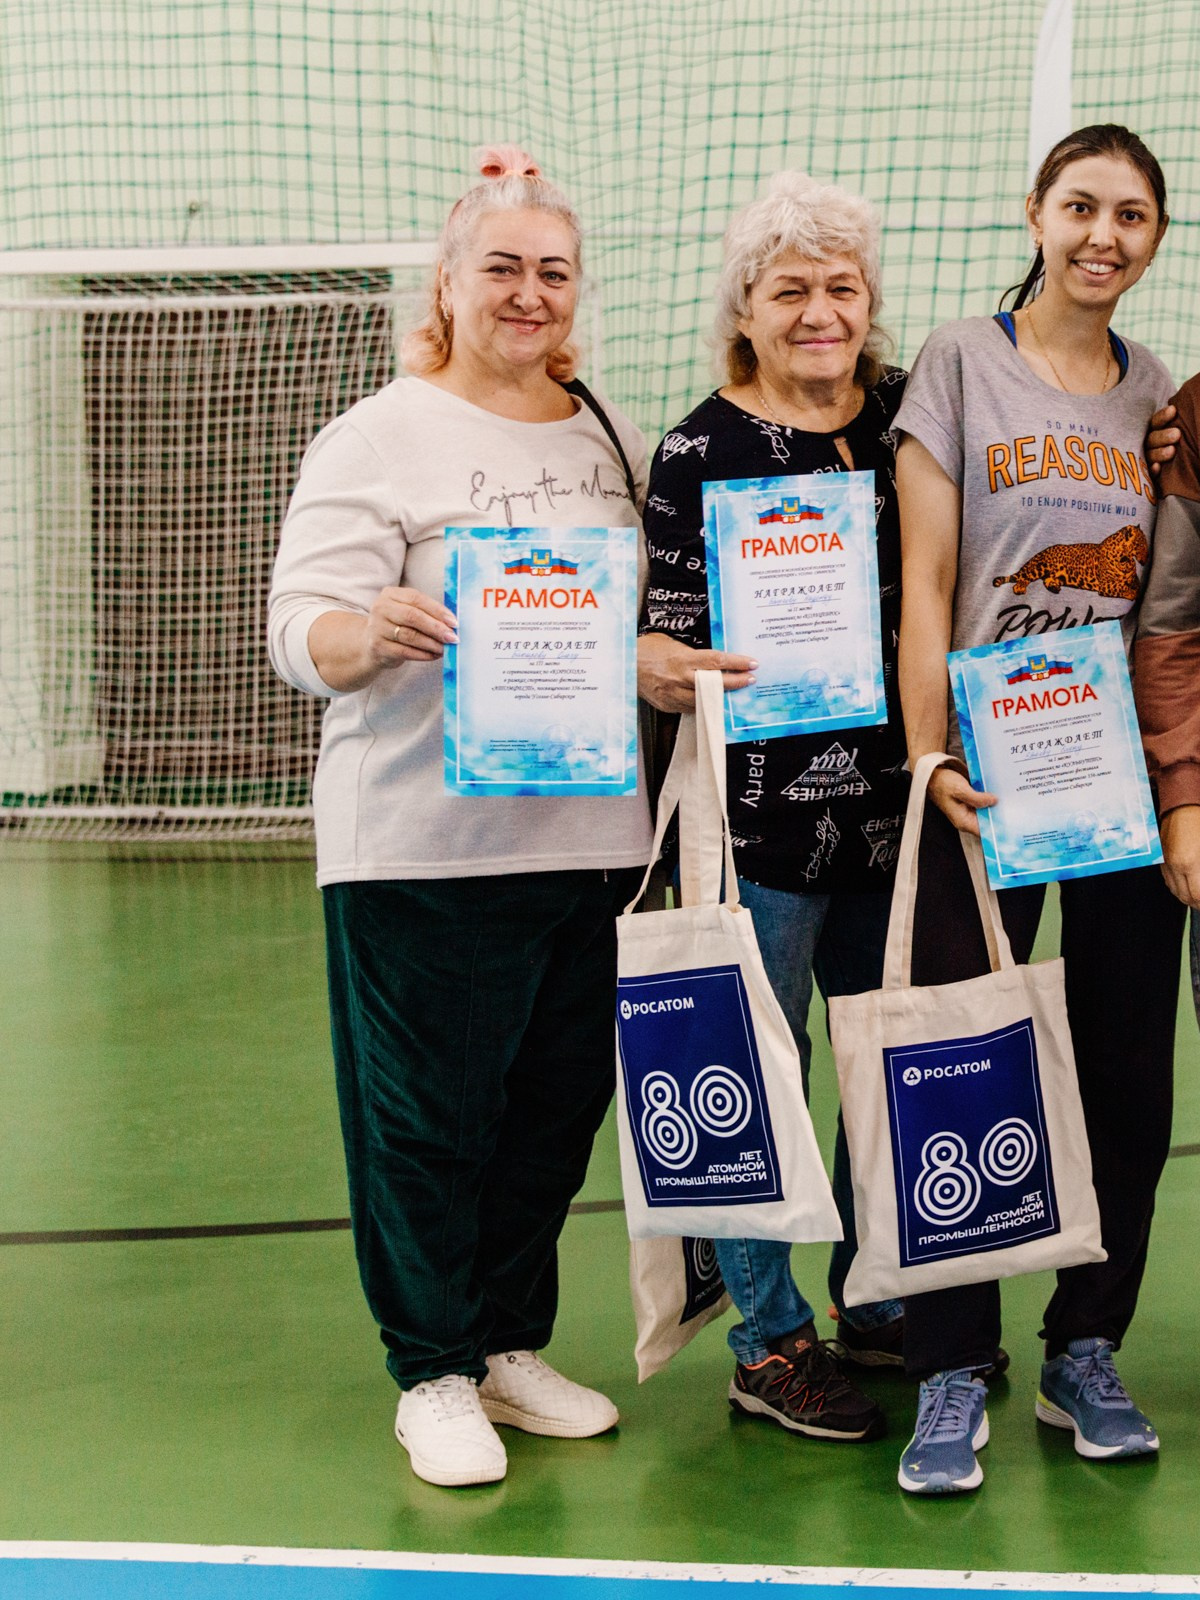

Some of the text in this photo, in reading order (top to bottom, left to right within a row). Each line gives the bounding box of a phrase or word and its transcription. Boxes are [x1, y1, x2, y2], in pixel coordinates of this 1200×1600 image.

[1046, 420, 1099, 437] SO MANY
[470, 470, 538, 527] Enjoy
[535, 467, 573, 510] the
[1021, 497, 1137, 517] TO ENJOY POSITIVE WILD
[741, 532, 844, 559] ГРАМОТА
[482, 587, 599, 609] ГРАМОТА
[754, 581, 846, 599] НАГРАЖДАЕТ
[493, 640, 598, 651] НАГРАЖДАЕТ
[991, 683, 1098, 719] ГРАМОТА
[1010, 729, 1103, 754] НАГРАЖДАЕТ
[739, 753, 766, 808] party
[789, 782, 864, 801] EIGHTIES
[633, 997, 694, 1016] РОСАТОМ
[923, 1059, 991, 1080] РОСАТОМ
[640, 1064, 752, 1170] 80
[739, 1150, 763, 1162] ЛЕТ
[707, 1160, 765, 1174] АТОМНОЙ
[914, 1116, 1038, 1226] 80
[655, 1171, 768, 1187] ПРОМЫШЛЕННОСТИ
[1021, 1190, 1042, 1205] ЛЕТ
[985, 1199, 1044, 1224] АТОМНОЙ
[918, 1209, 1046, 1246] ПРОМЫШЛЕННОСТИ
